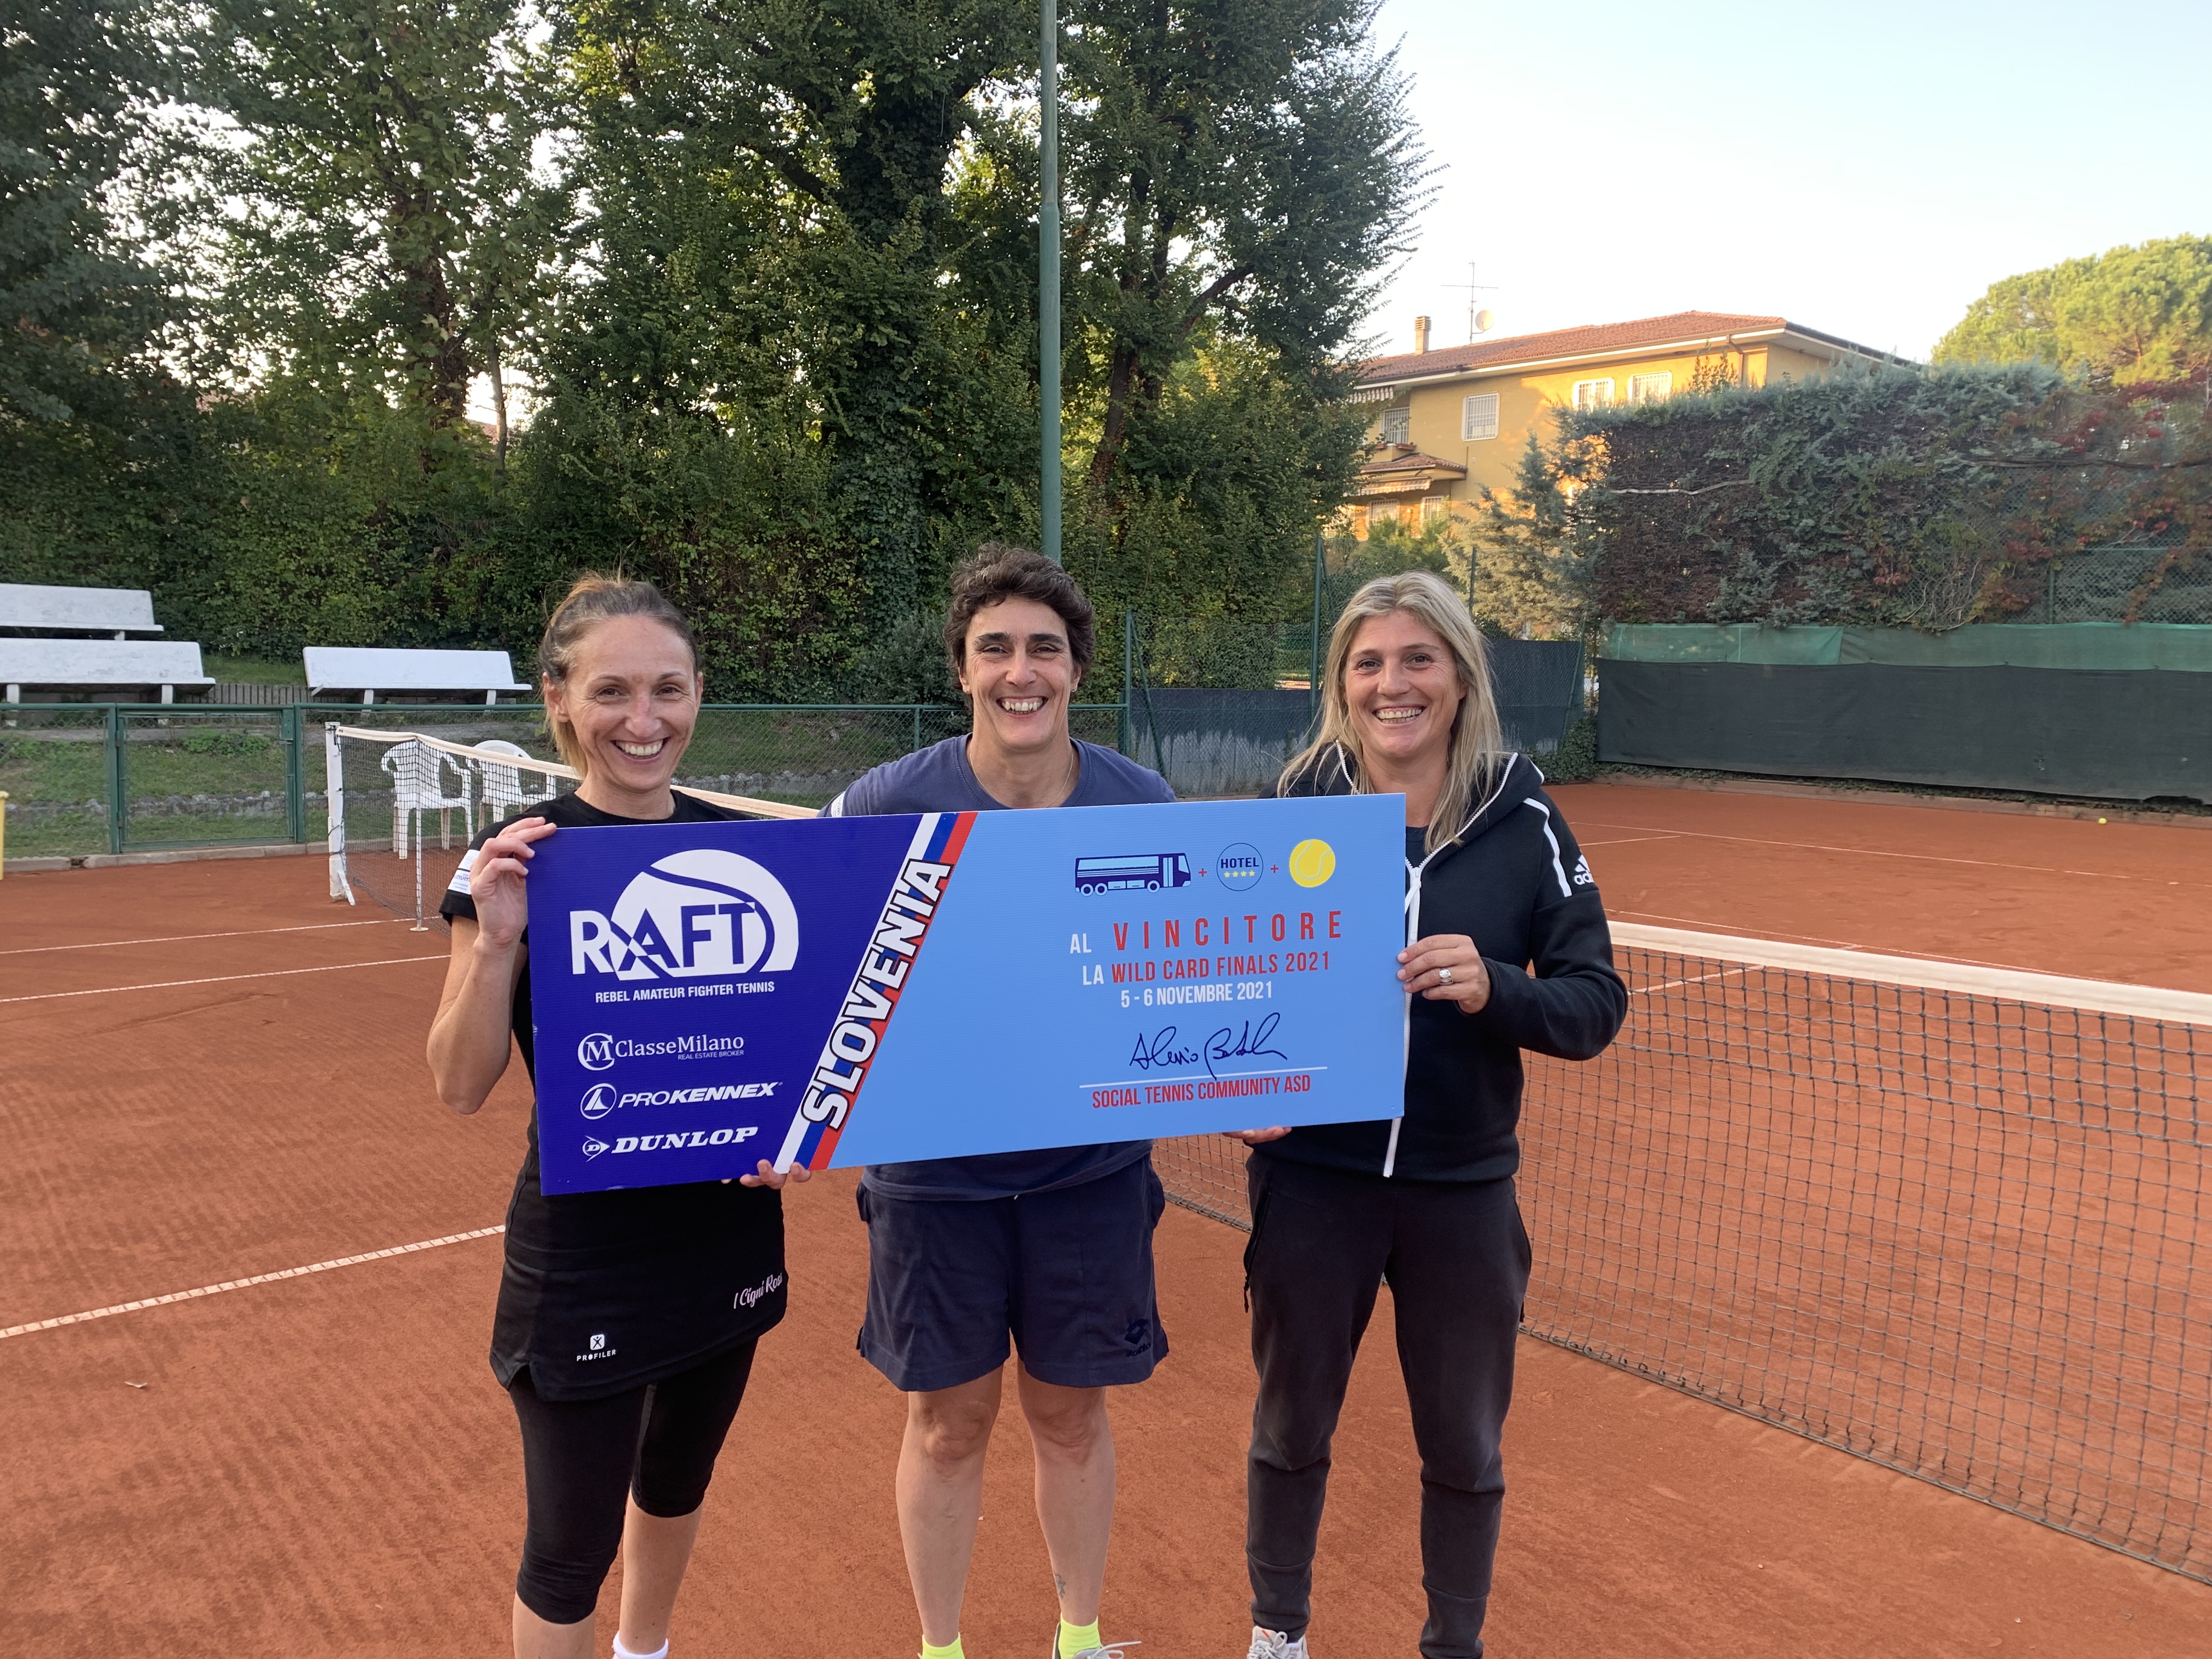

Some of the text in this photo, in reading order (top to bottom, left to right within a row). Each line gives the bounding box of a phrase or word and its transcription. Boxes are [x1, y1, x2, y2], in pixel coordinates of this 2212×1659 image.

[1221, 857, 1260, 869] HOTEL
[569, 902, 755, 975] RAFT
[1070, 910, 1342, 953] AL VINCITORE
[1083, 951, 1329, 985] LA WILD CARD FINALS 2021
[595, 981, 775, 1003] REBEL AMATEUR FIGHTER TENNIS
[801, 858, 955, 1130] SLOVENIA
[1156, 983, 1233, 1005] NOVEMBRE
[1237, 981, 1272, 1000] 2021
[615, 1034, 744, 1057] ClasseMilano
[618, 1082, 779, 1108] PROKENNEX
[1092, 1074, 1311, 1109] SOCIAL TENNIS COMMUNITY ASD
[611, 1126, 758, 1154] DUNLOP
[740, 1280, 765, 1308] Cigni
[577, 1350, 616, 1362] PROFILER
